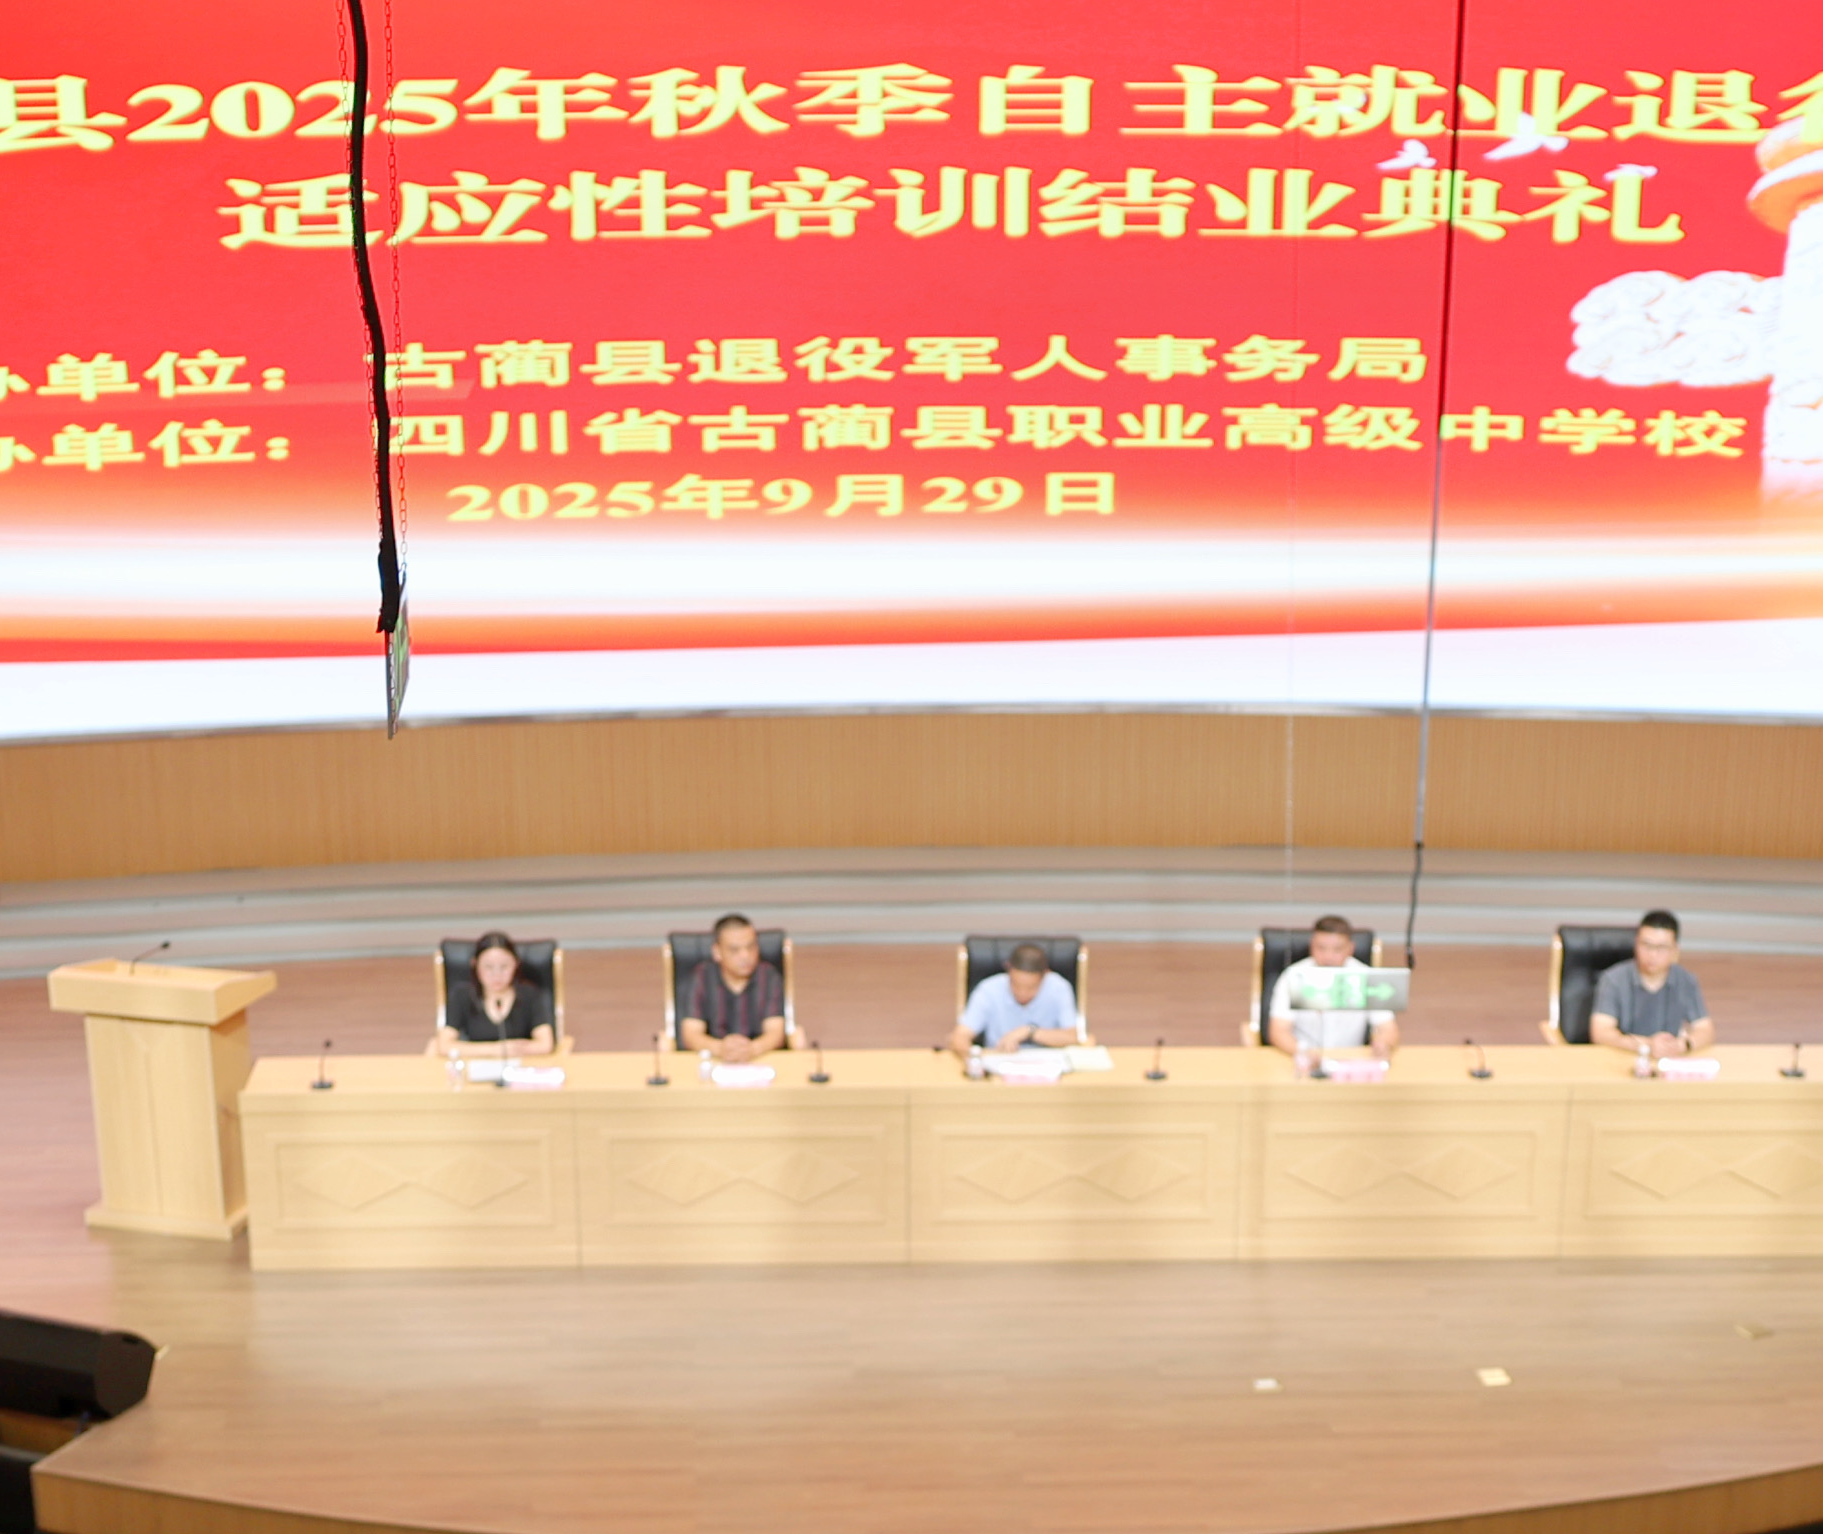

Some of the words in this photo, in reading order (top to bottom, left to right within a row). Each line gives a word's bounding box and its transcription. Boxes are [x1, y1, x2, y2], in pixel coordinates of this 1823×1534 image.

[219, 166, 1685, 249] 适应性培训结业典礼
[364, 335, 1427, 391] 古蔺县退役军人事务局
[374, 403, 1748, 457] 四川省古蔺县职业高级中学校
[444, 472, 1116, 523] 2025年9月29日
